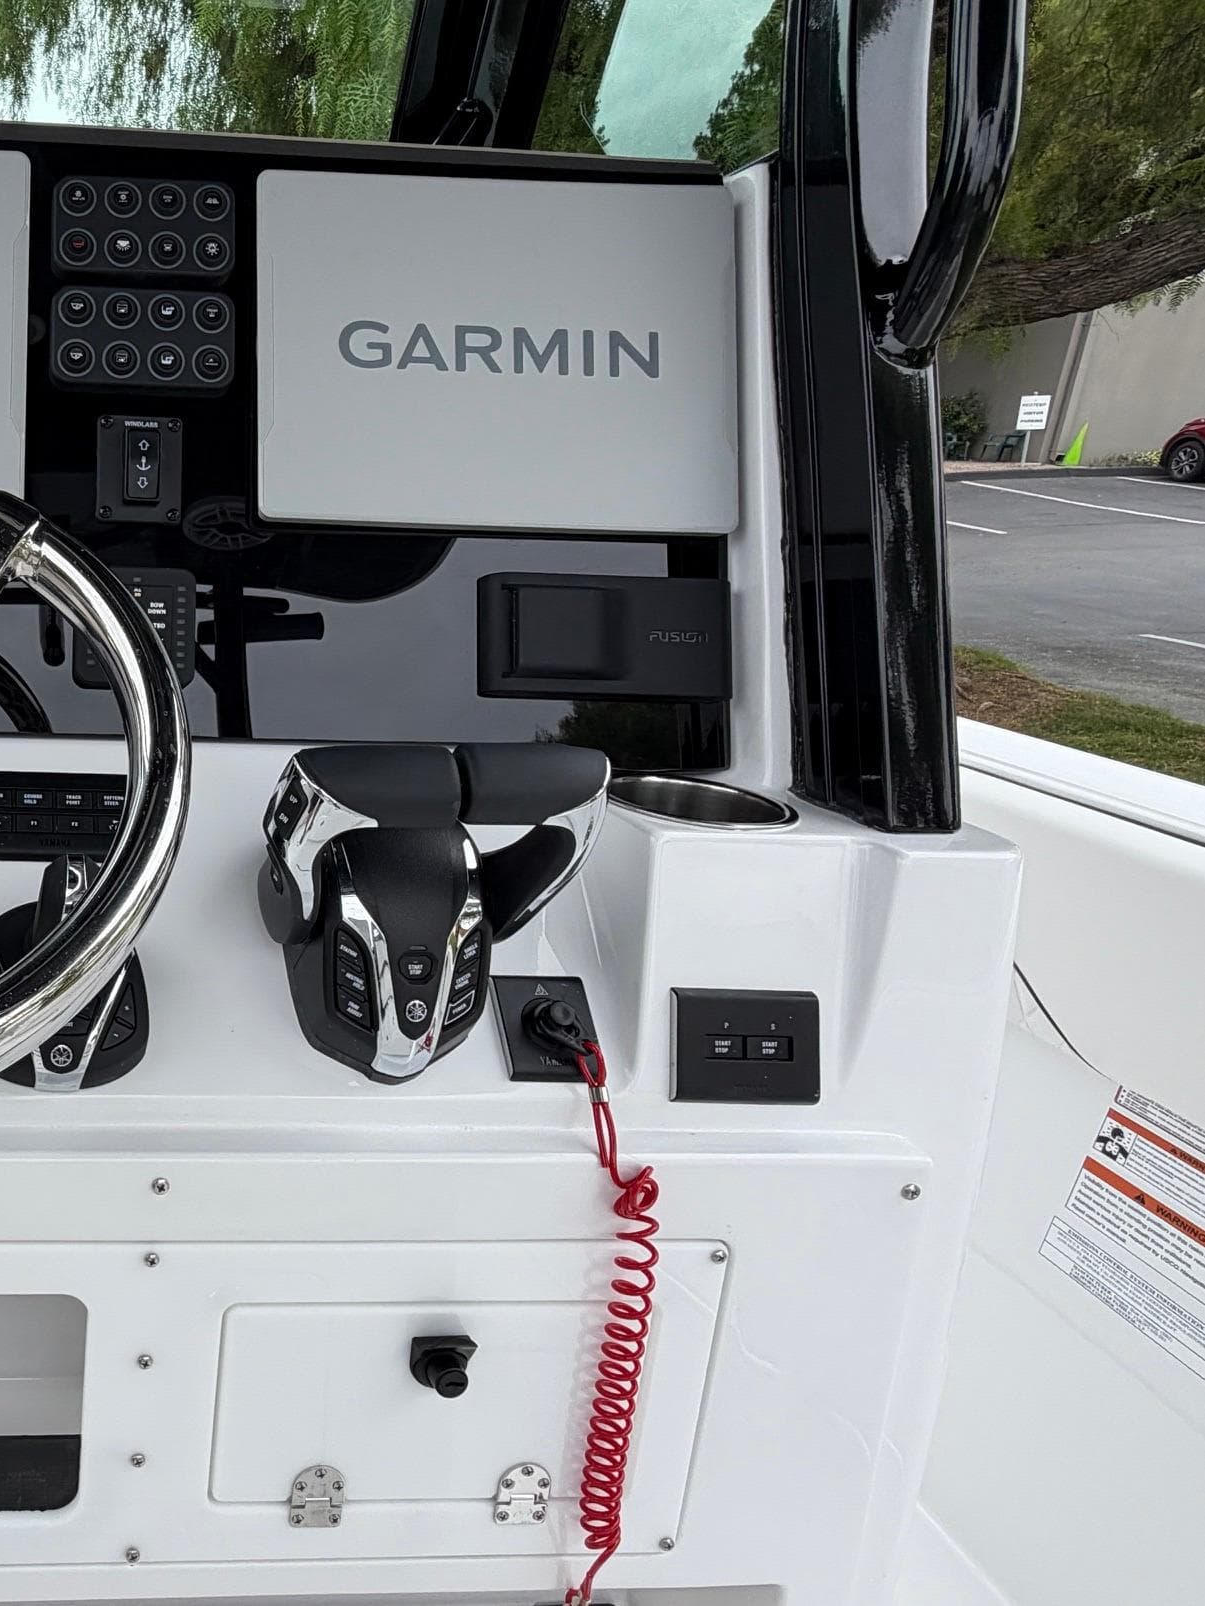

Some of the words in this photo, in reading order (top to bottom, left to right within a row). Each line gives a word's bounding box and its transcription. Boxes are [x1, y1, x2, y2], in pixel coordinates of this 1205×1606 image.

[338, 320, 660, 379] GARMIN
[124, 420, 158, 428] WINDLASS
[649, 630, 709, 644] FUSION
[289, 794, 298, 804] UP
[279, 812, 289, 824] DN
[1123, 1210, 1147, 1229] standing
[1147, 1216, 1168, 1233] position
[1156, 1204, 1205, 1245] WARNING
